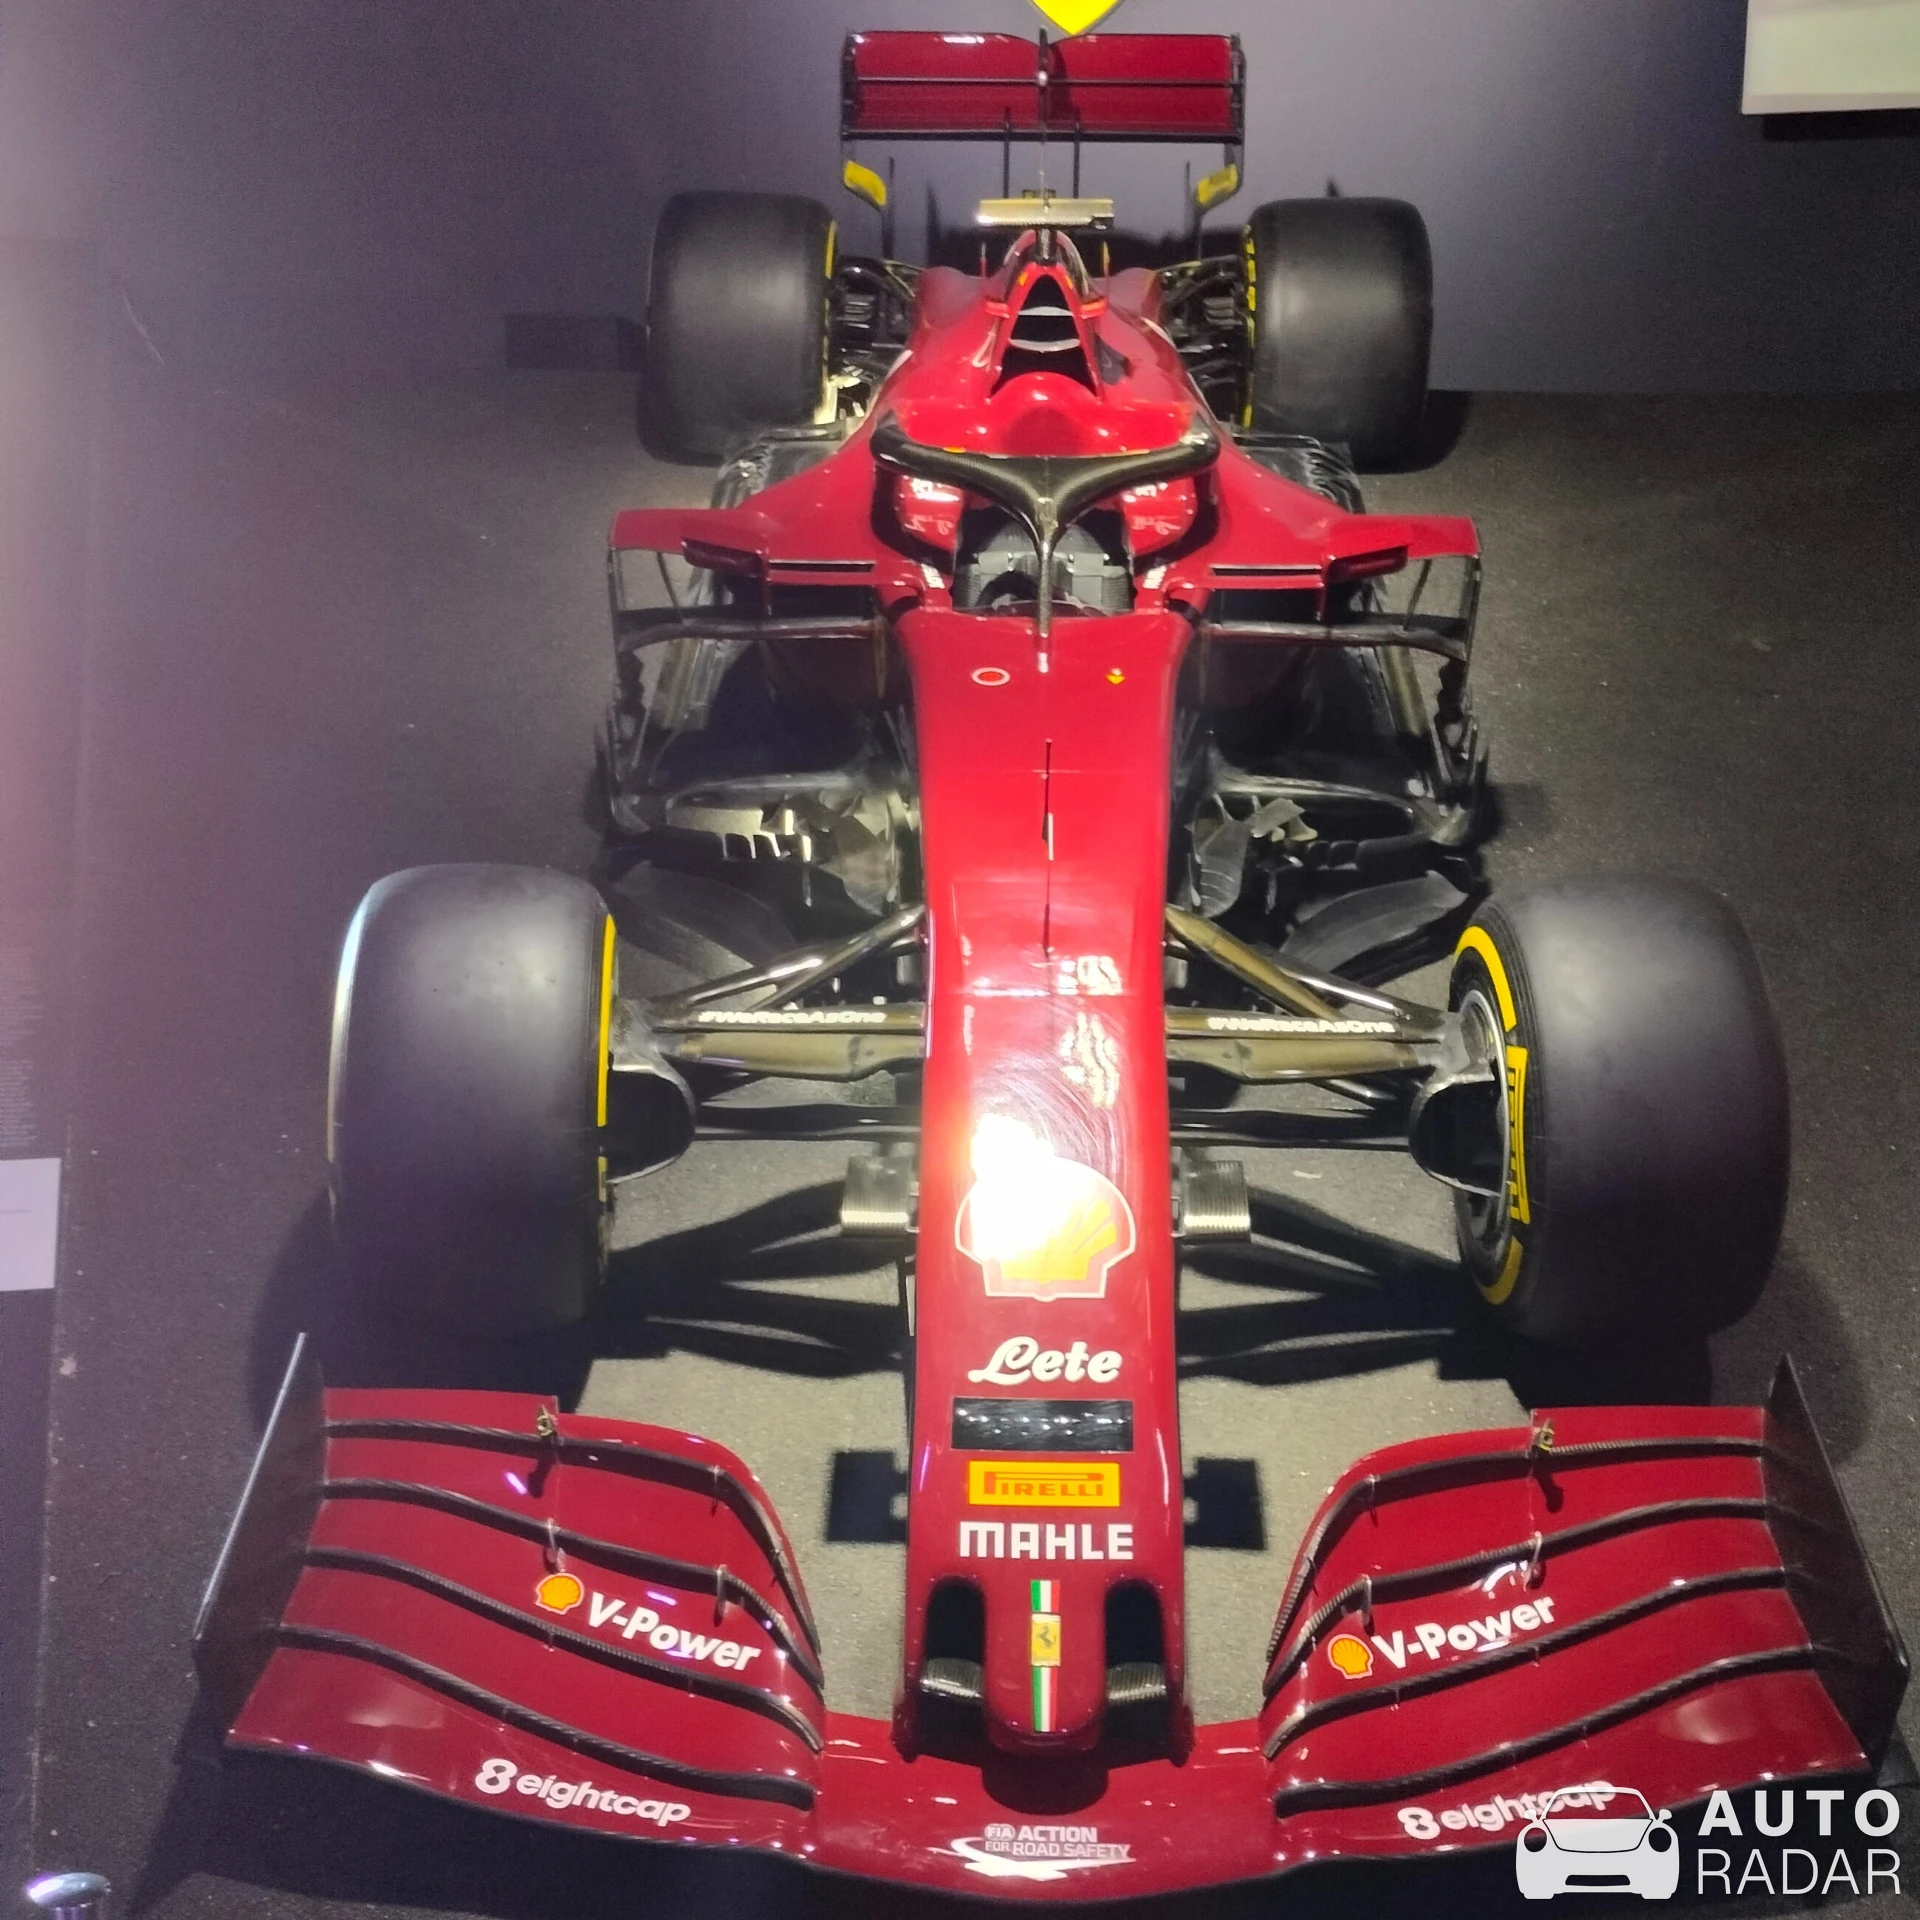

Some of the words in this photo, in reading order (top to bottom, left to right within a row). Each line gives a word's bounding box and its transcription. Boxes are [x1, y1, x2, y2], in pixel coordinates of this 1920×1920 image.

[967, 1336, 1123, 1386] Lete
[983, 1471, 1105, 1497] PIRELLI
[959, 1521, 1134, 1560] MAHLE
[587, 1591, 761, 1670] V-Power
[1370, 1596, 1556, 1669] V-Power
[516, 1775, 691, 1827] eightcap
[1440, 1780, 1617, 1832] eightcap
[985, 1841, 1010, 1852] FOR
[1012, 1842, 1060, 1857] ROAD
[1063, 1843, 1132, 1859] SAFETY
[986, 1825, 1014, 1840] FIA
[1017, 1825, 1098, 1843] ACTION
